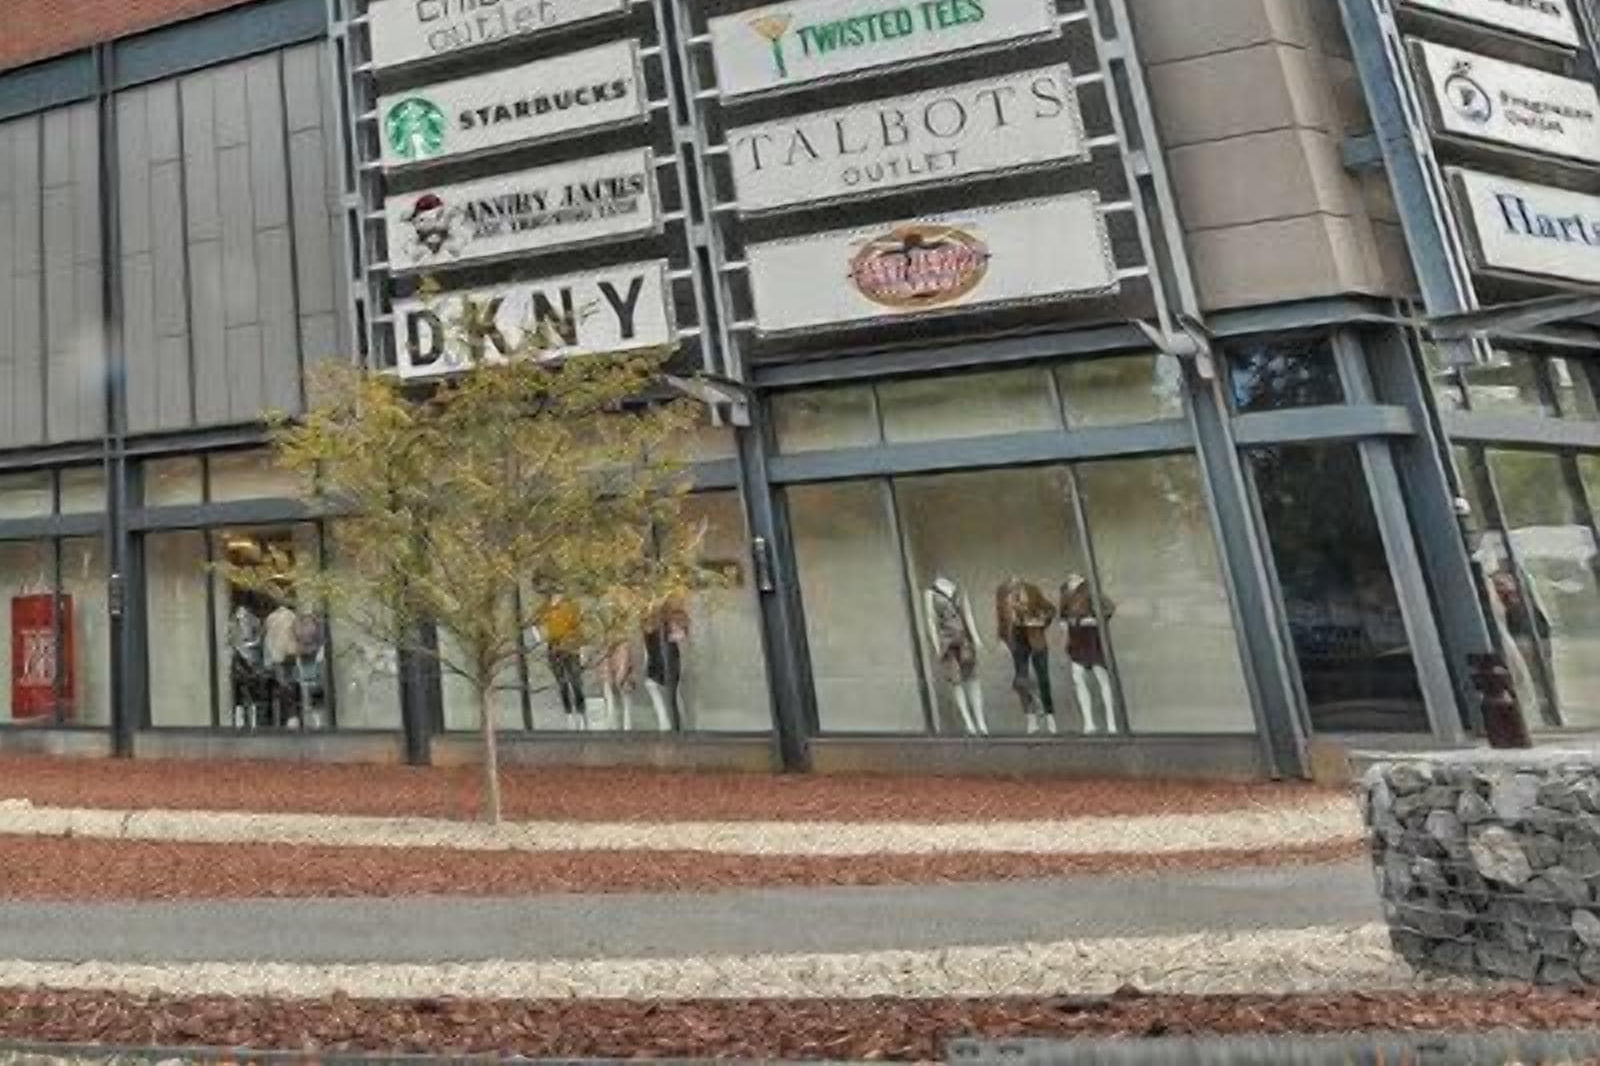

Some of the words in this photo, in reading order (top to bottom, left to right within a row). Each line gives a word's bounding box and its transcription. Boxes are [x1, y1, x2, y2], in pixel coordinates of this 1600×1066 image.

[796, 7, 913, 57] TWISTED
[458, 78, 629, 131] STARBUCKS
[739, 76, 1064, 171] TALBOTS
[842, 148, 959, 186] OUTLET
[404, 274, 644, 367] DKNY
